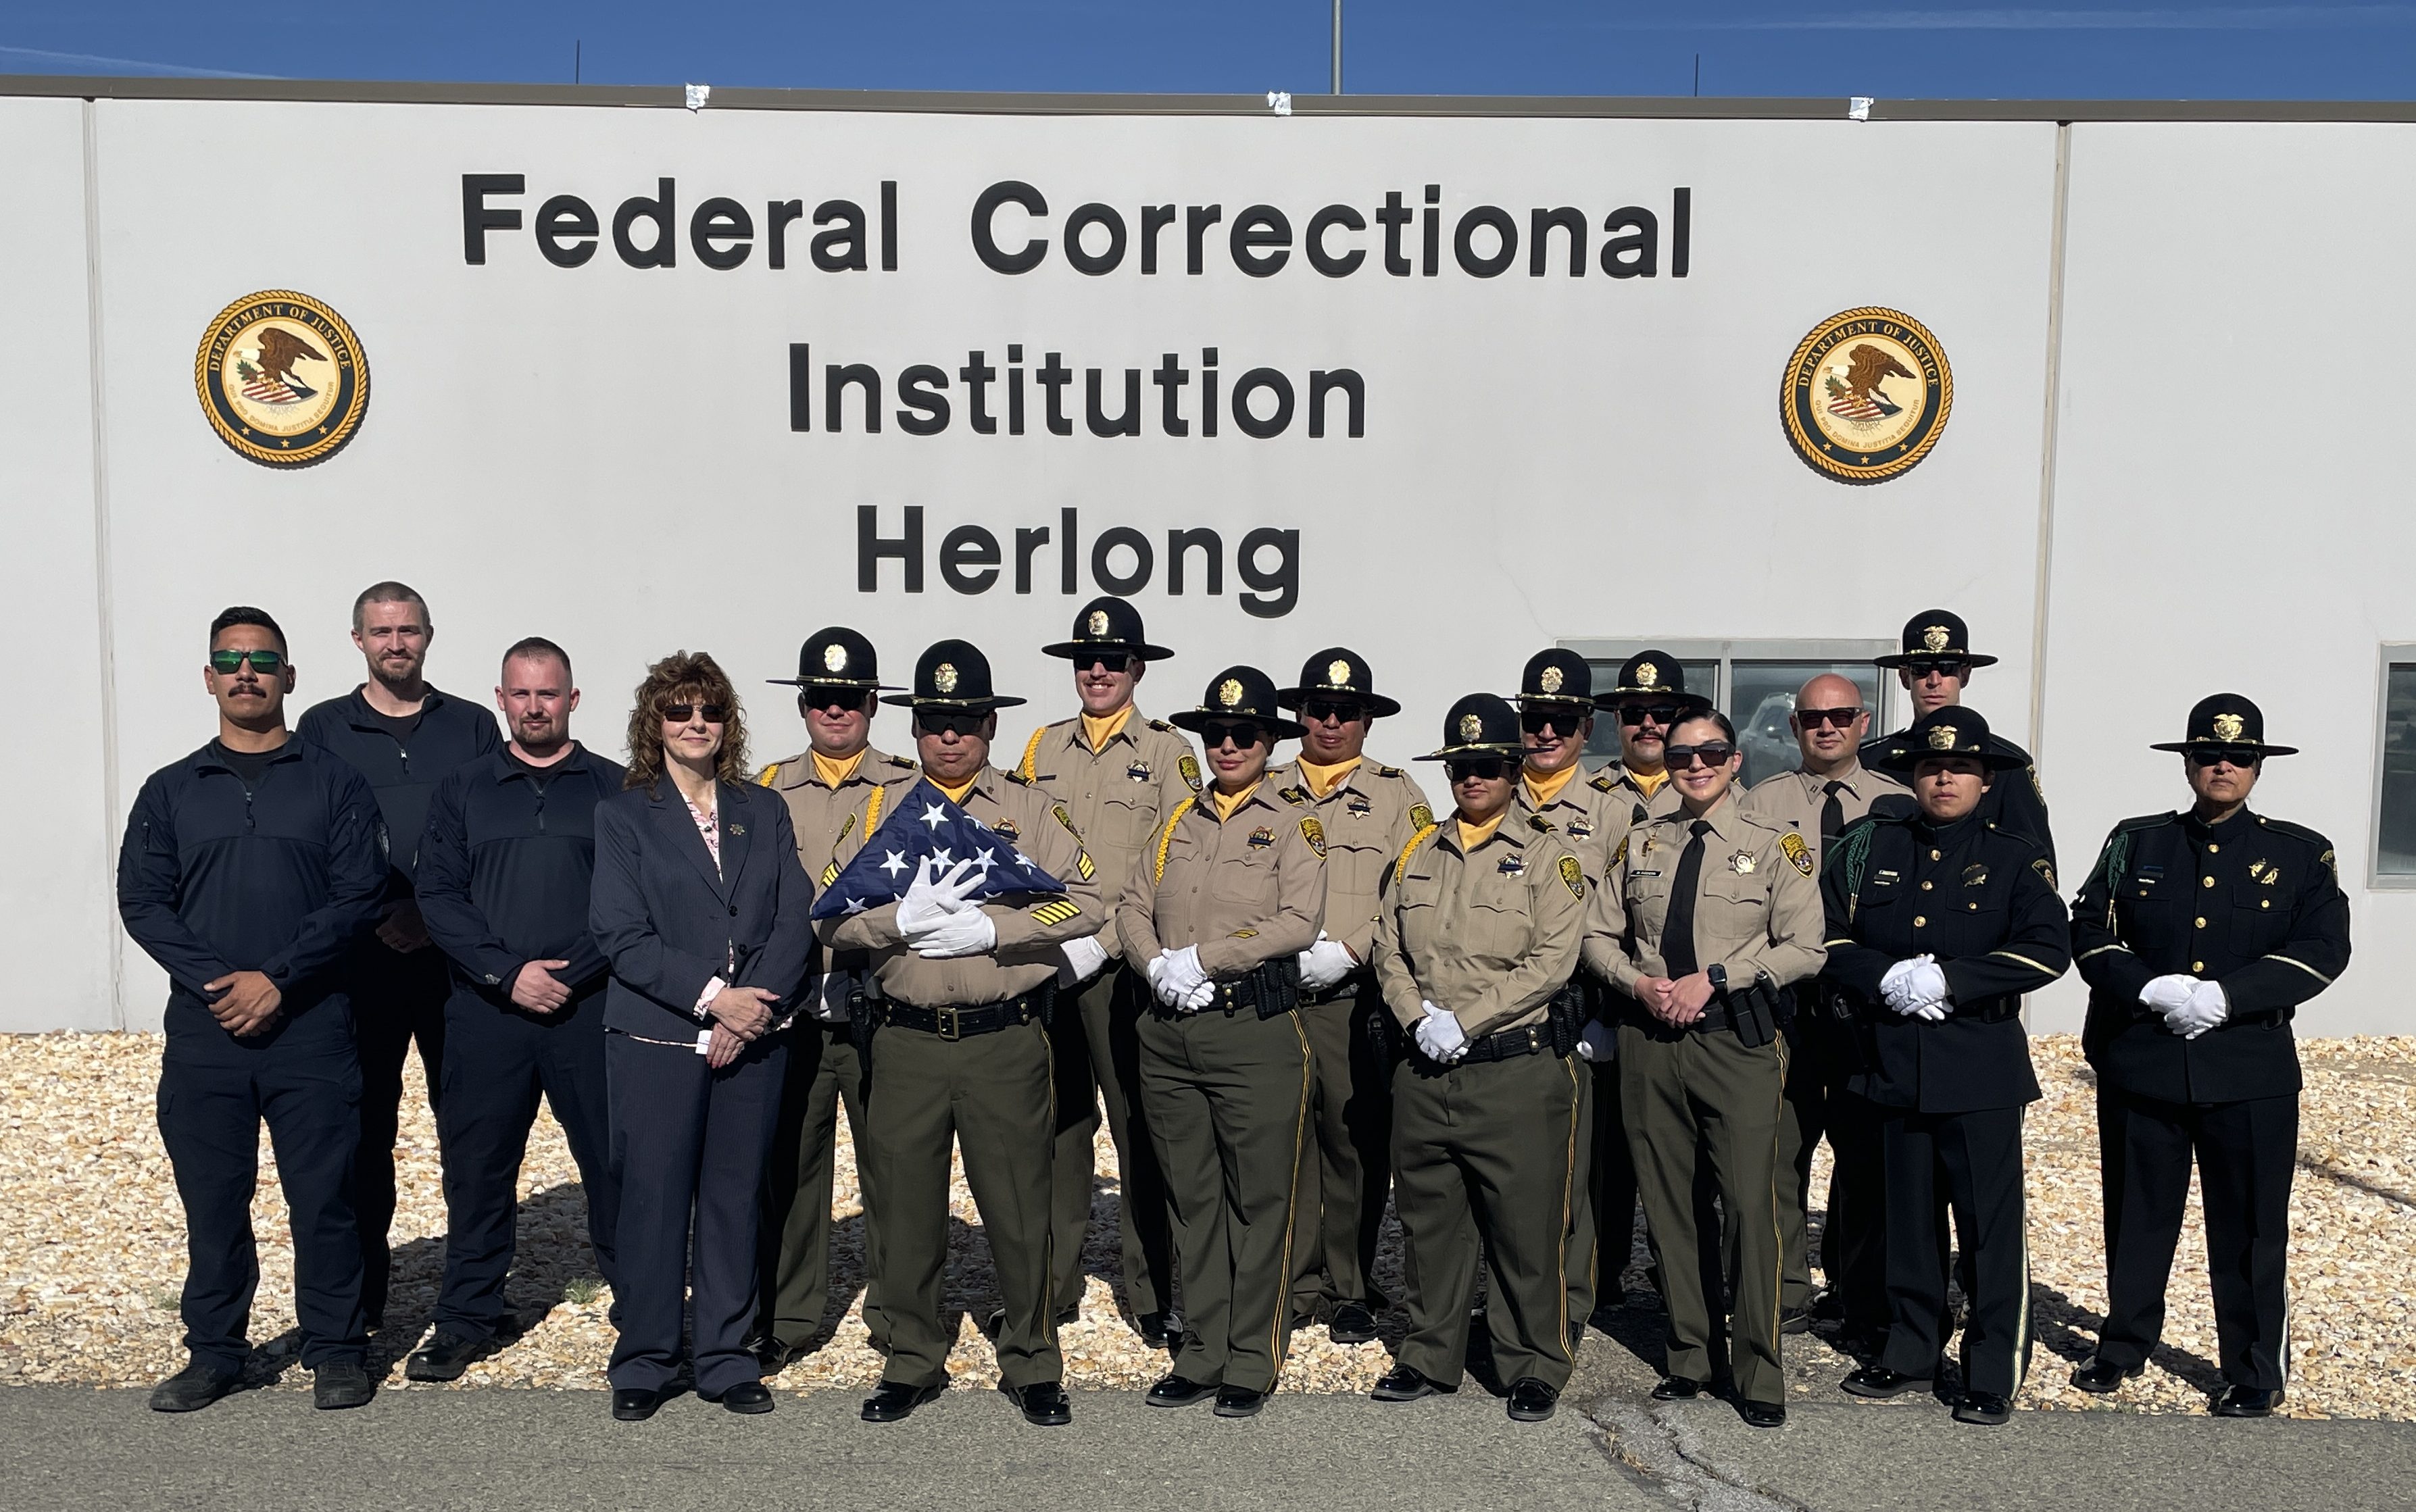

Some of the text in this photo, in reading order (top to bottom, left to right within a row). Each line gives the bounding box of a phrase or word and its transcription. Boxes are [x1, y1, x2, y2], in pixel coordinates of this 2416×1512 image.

[462, 174, 1691, 279] Federal Correctional
[208, 303, 351, 373] DEPARTMENT OF JUSTICE
[1798, 321, 1940, 387] DEPARTMENT OF JUSTICE
[235, 400, 248, 415] PRO
[249, 415, 278, 431] DOMINA
[282, 417, 316, 432] JUSTITIA
[314, 381, 335, 418] SEQUITUR
[789, 343, 1365, 439] Institution
[1815, 399, 1920, 449] QUI PRO DOMINA JUSTITIA SEQUITUR
[857, 505, 1301, 619] Herlong
